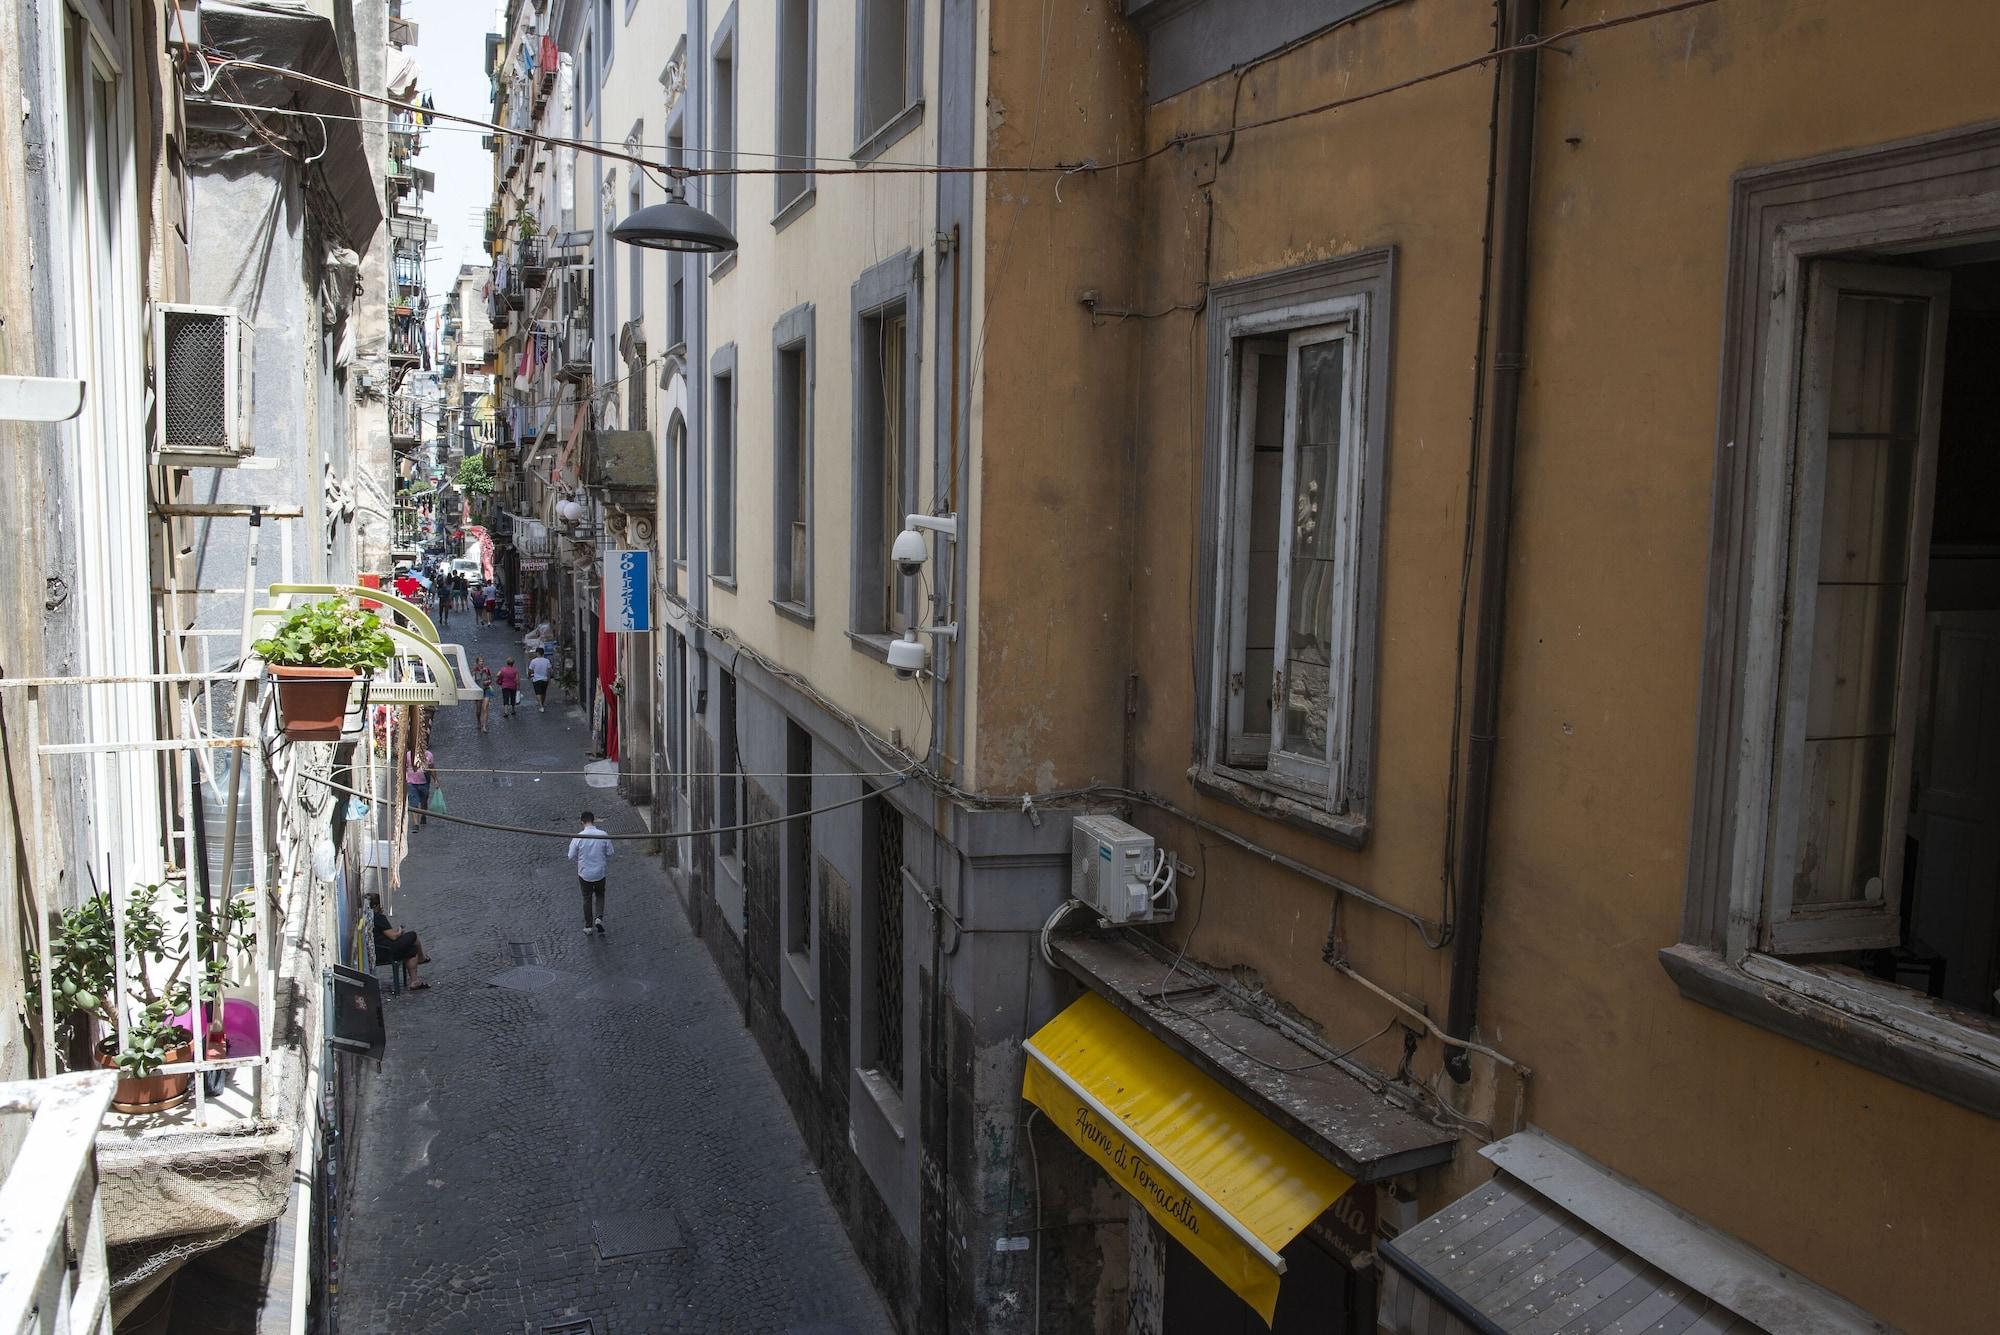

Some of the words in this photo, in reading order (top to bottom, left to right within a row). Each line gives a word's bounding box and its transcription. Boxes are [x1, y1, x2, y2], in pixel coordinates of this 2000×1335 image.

[620, 551, 634, 618] POLIZIA
[1075, 1107, 1112, 1156] Anime
[1114, 1143, 1127, 1170] di
[1130, 1155, 1199, 1234] Terracotta
